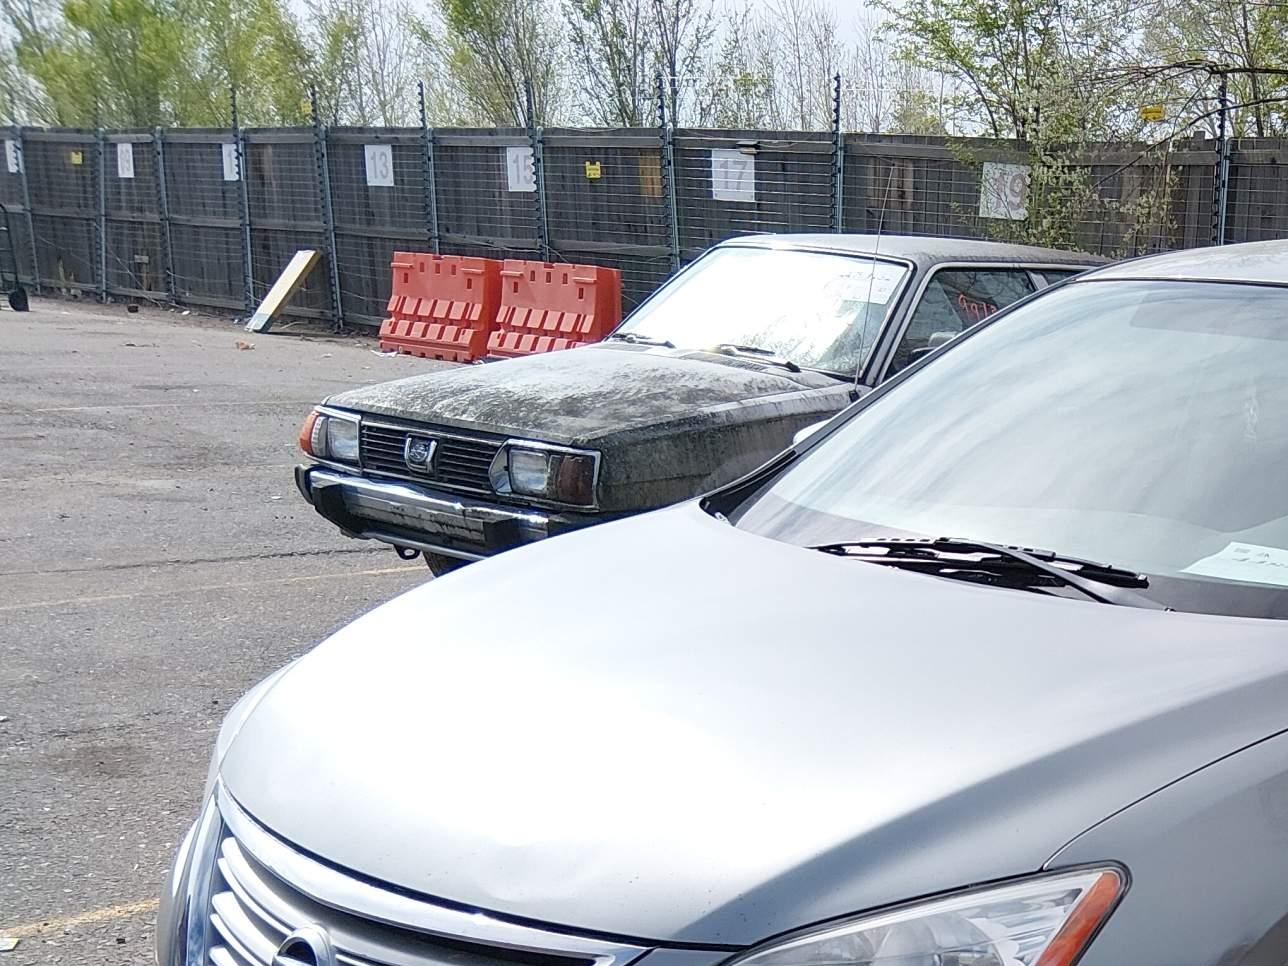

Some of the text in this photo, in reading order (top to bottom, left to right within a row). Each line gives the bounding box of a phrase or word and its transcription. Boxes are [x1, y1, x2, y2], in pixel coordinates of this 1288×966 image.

[370, 152, 389, 179] 13
[512, 154, 533, 185] 15
[720, 158, 748, 190] 17
[993, 173, 1028, 210] 19
